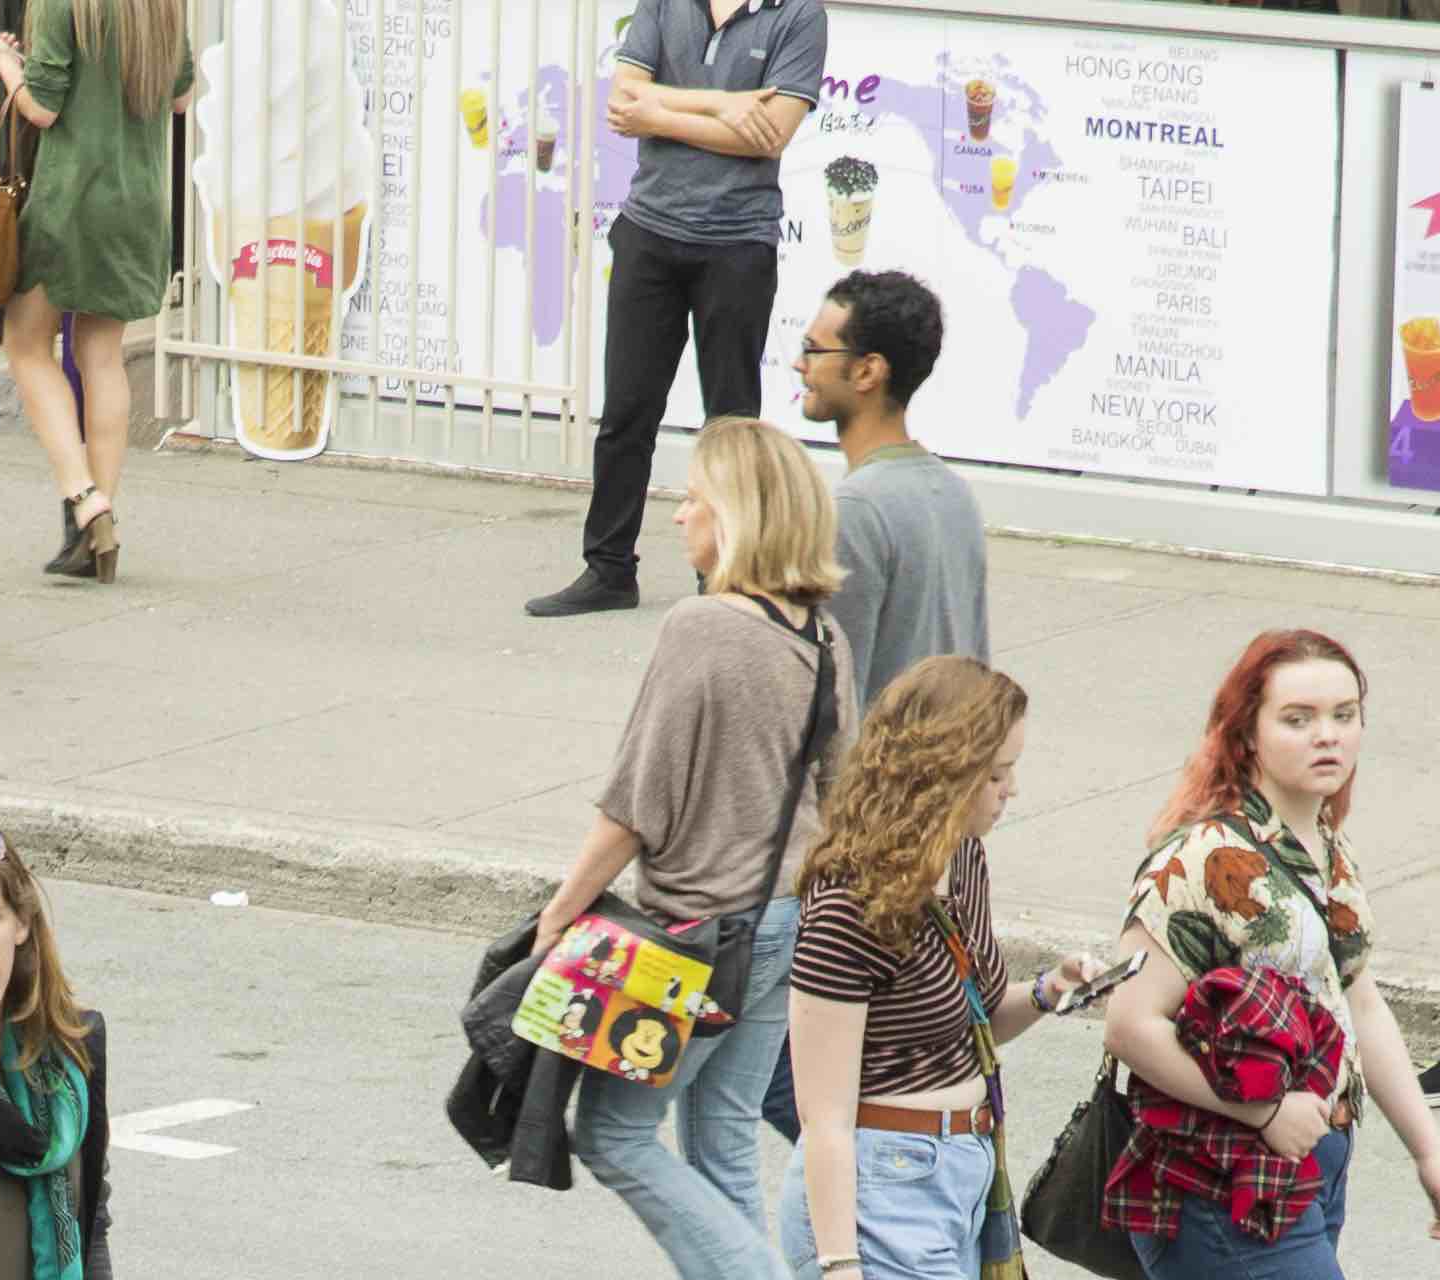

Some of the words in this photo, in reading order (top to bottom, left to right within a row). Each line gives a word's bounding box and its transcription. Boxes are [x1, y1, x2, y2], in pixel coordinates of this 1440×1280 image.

[1065, 55, 1132, 81] HONG
[1138, 60, 1204, 87] KONG
[1131, 84, 1200, 104] PENANG
[1085, 116, 1225, 148] MONTREAL
[954, 145, 993, 156] CANADA
[1119, 155, 1195, 176] SHANGHAI
[1137, 175, 1214, 205] TAIPEI
[1125, 215, 1179, 233] WUHAN
[1183, 225, 1229, 249] BALI
[1156, 291, 1213, 315] PARIS
[1114, 352, 1201, 382] MANILA
[1090, 392, 1144, 418] NEW
[1151, 399, 1217, 427] YORK
[1071, 425, 1156, 452] BANGKOK
[1135, 419, 1188, 438] SEOUL
[1175, 439, 1217, 457] DUBAI
[1390, 424, 1414, 466] 4
